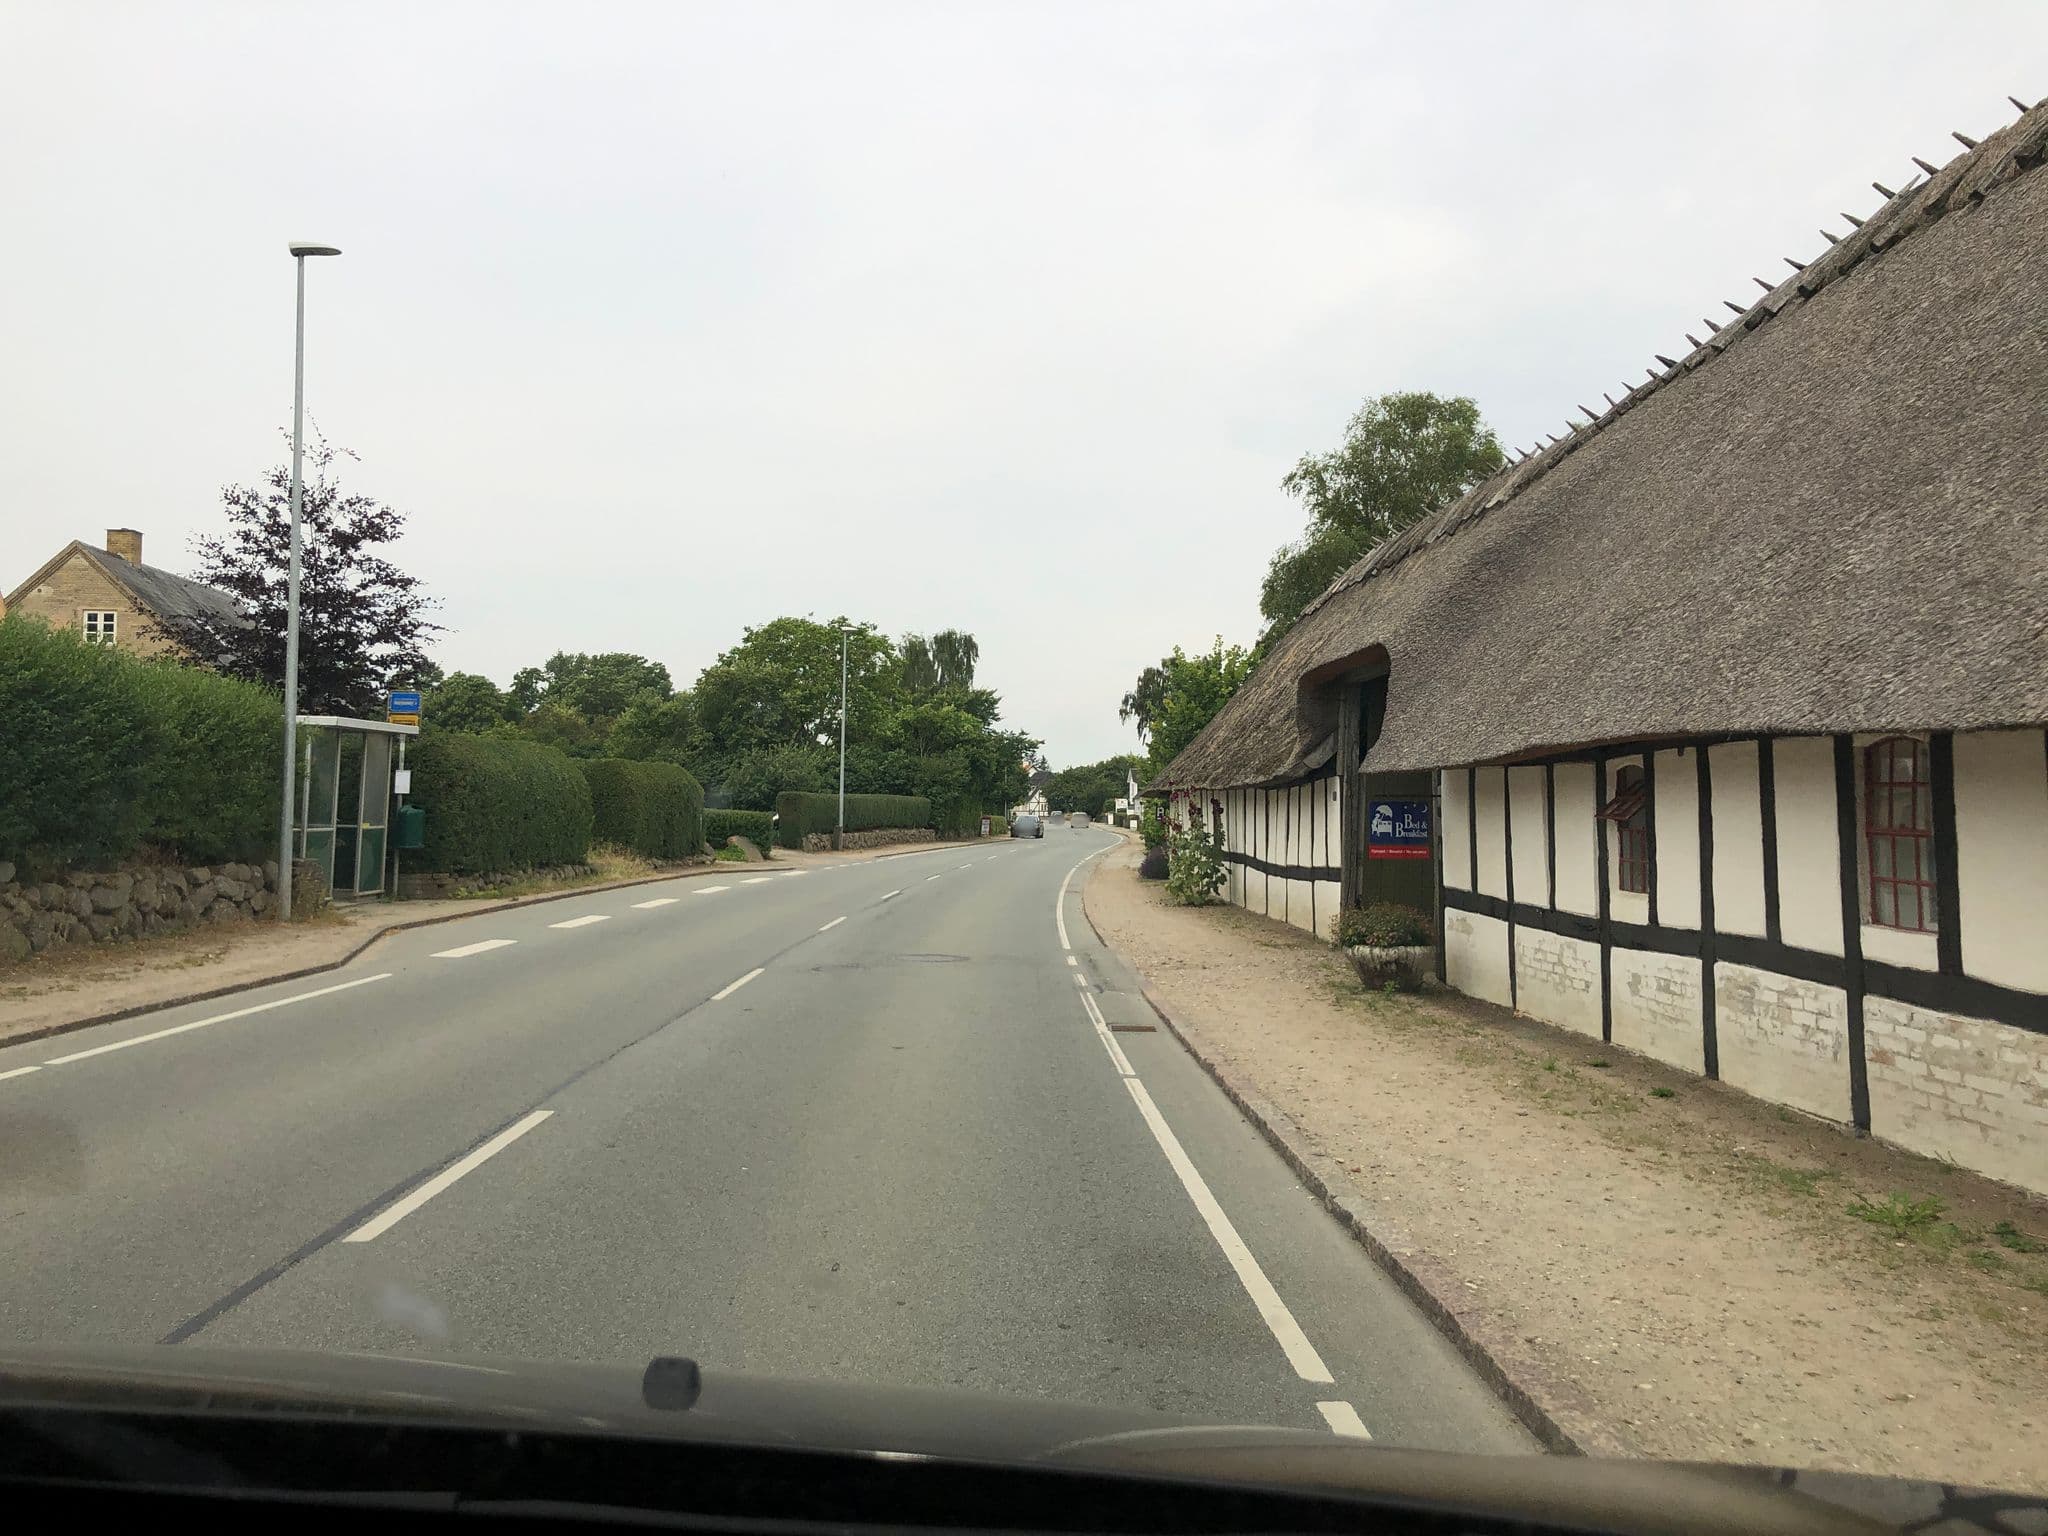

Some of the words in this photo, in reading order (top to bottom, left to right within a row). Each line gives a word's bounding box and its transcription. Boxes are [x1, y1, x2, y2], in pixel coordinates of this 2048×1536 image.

[1404, 813, 1420, 829] Bed
[1421, 821, 1428, 829] &
[1395, 822, 1428, 837] Breakfast
